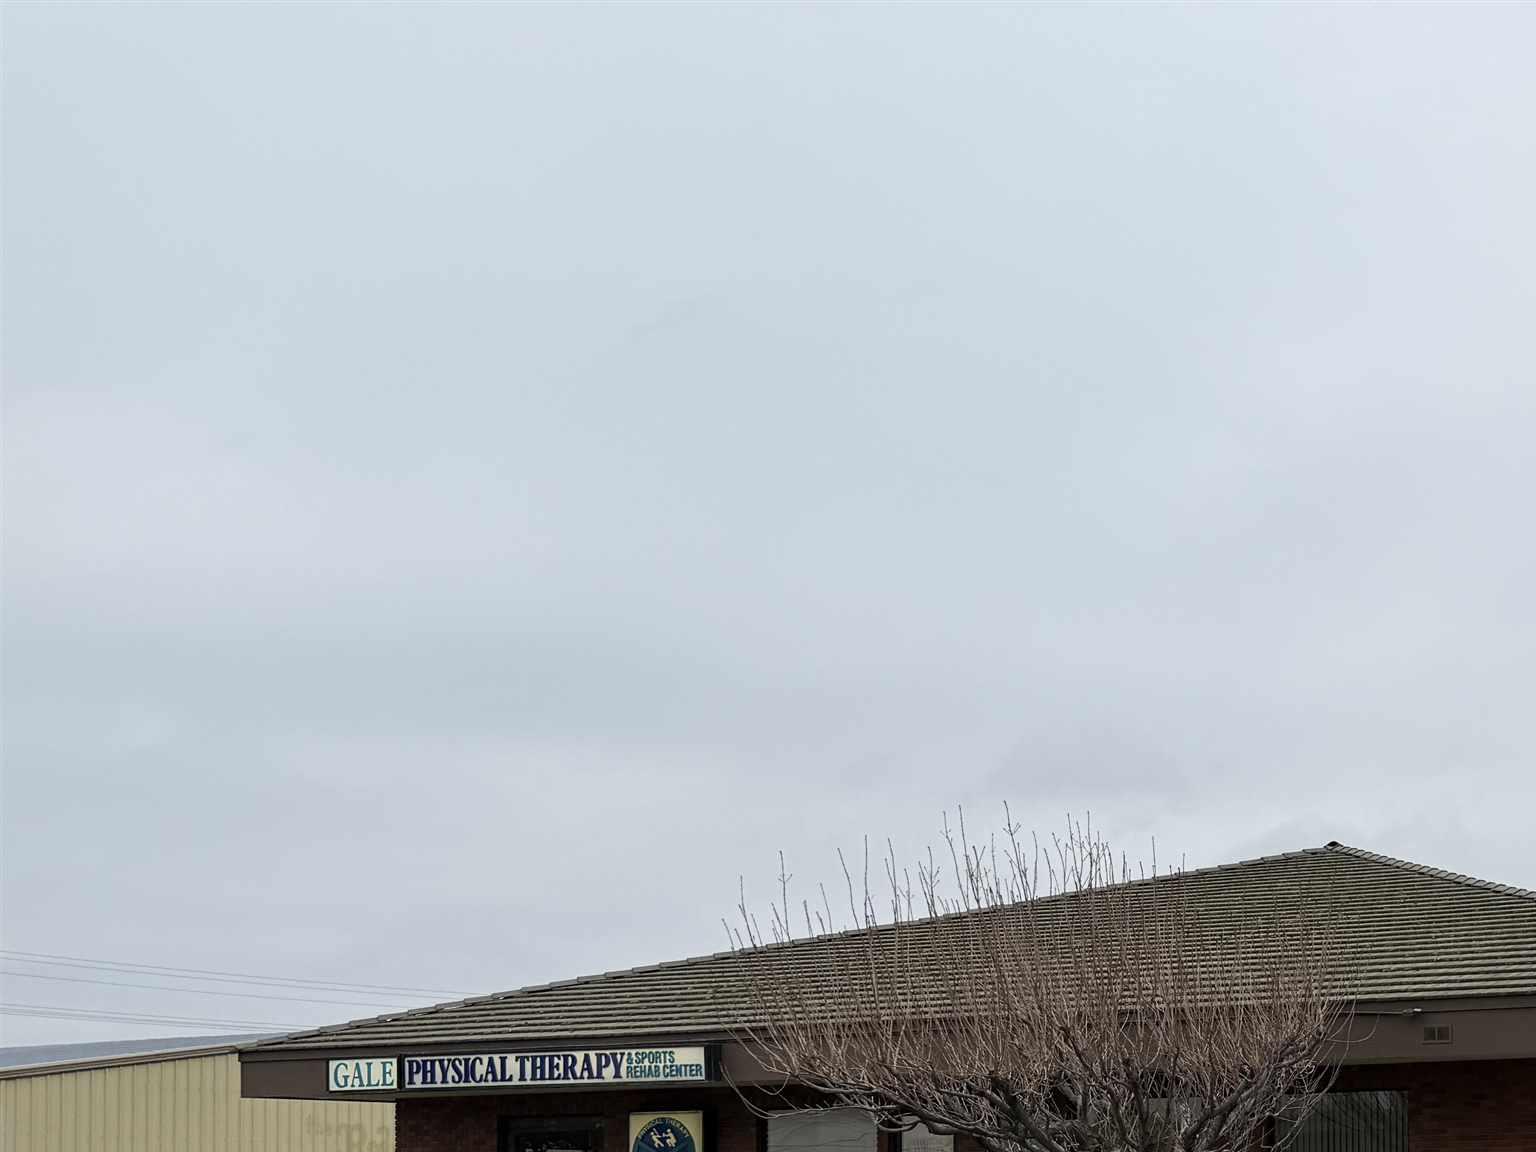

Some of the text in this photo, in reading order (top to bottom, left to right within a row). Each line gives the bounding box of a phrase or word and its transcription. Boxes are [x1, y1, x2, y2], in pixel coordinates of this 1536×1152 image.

[626, 1050, 675, 1065] & SPORTS
[334, 1061, 394, 1088] GALE
[406, 1052, 625, 1085] PHYSICAL THERAPY
[626, 1063, 703, 1079] REHAB CENTER
